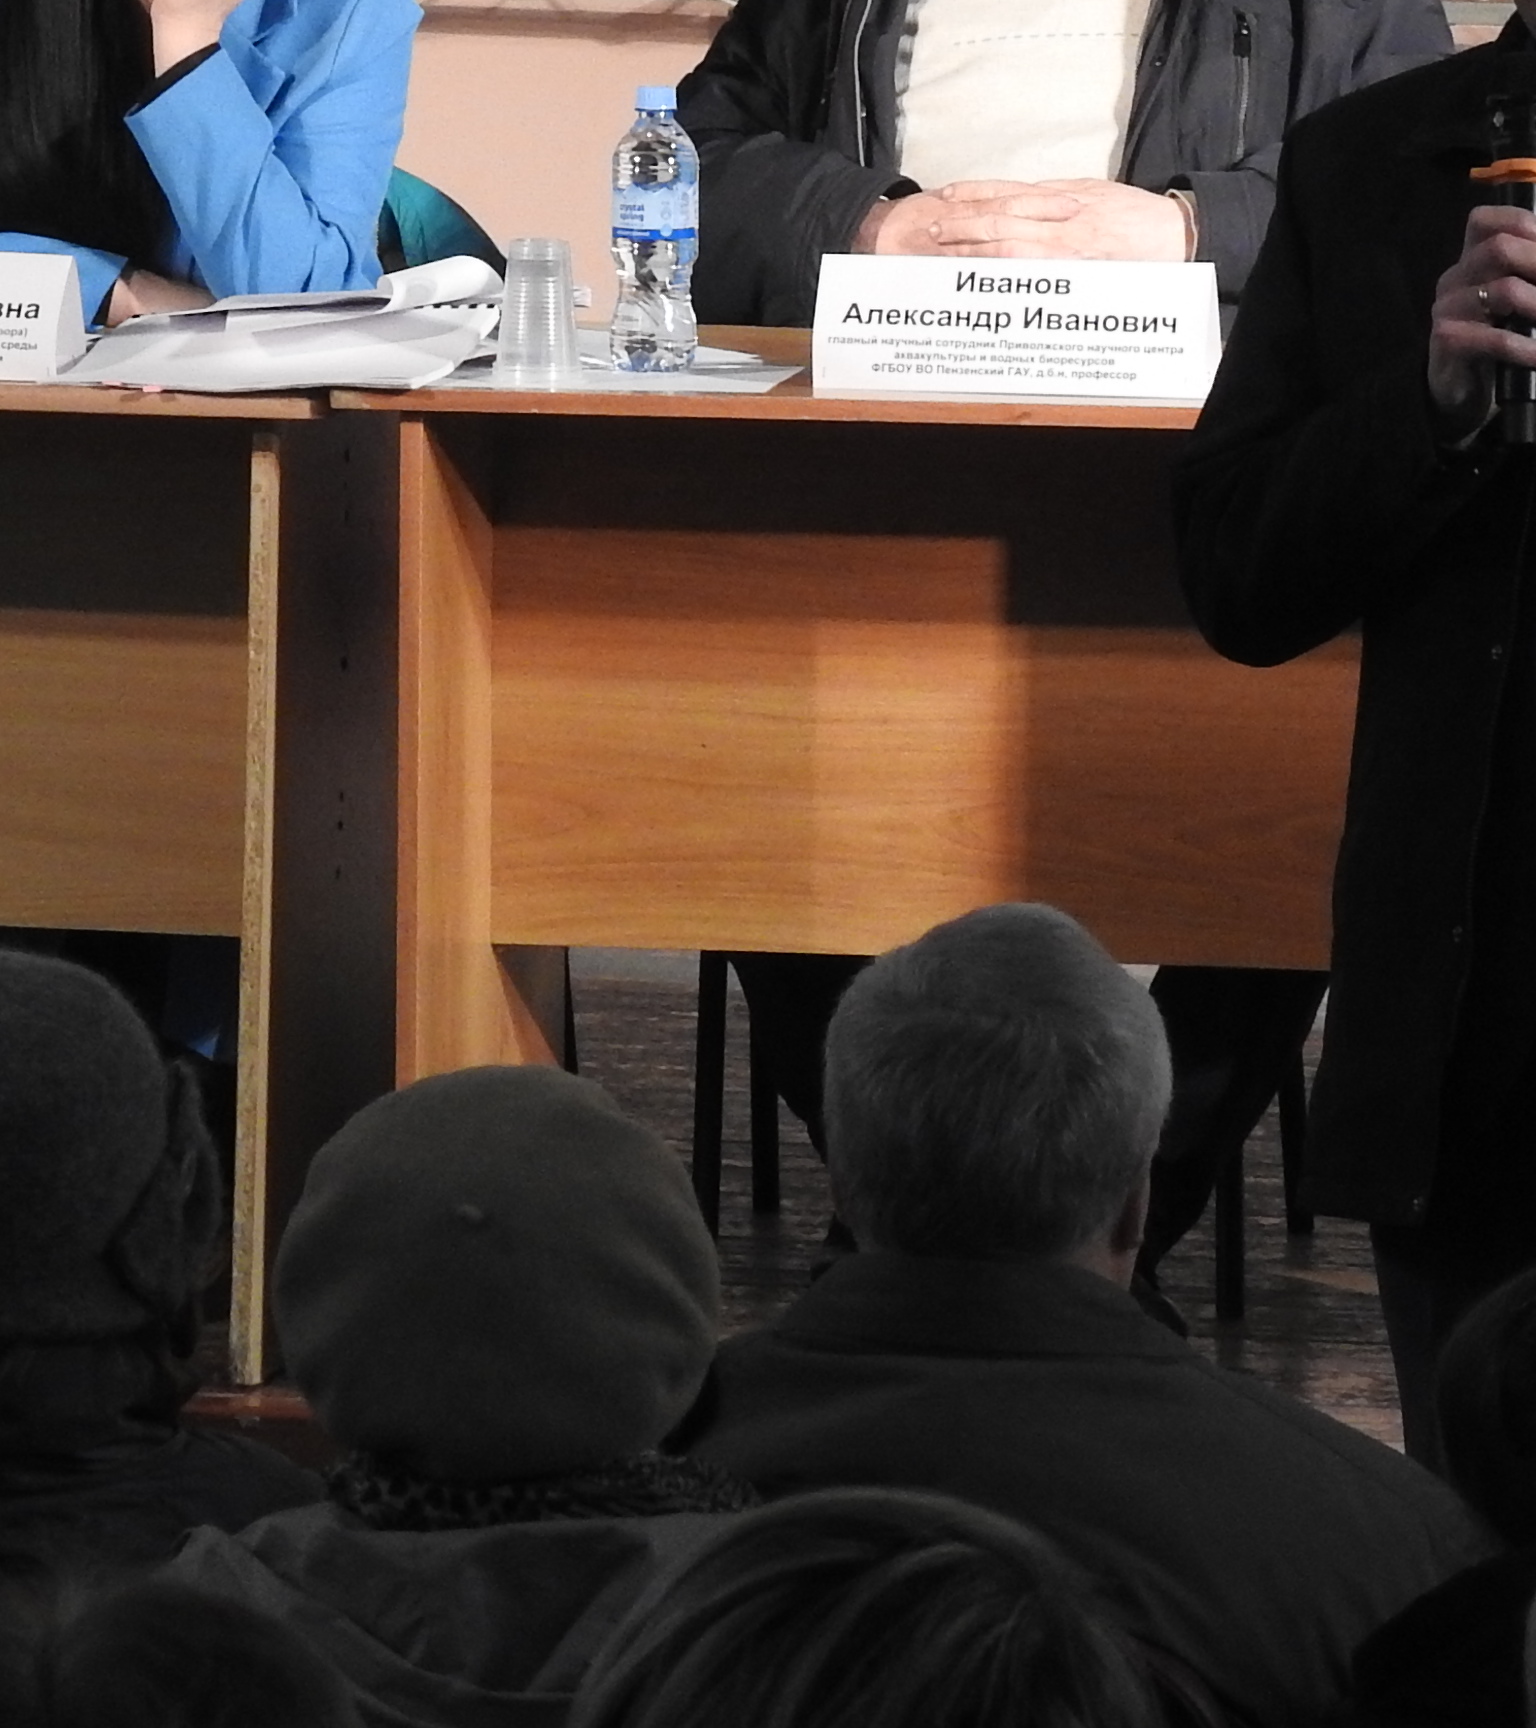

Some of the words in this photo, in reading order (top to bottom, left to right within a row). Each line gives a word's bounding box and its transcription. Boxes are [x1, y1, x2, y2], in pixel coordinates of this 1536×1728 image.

[955, 271, 1071, 295] Иванов
[841, 303, 1012, 334] Александр
[1023, 307, 1178, 334] Иванович
[1, 341, 37, 351] среды
[827, 335, 877, 345] главный
[881, 337, 932, 347] научный
[935, 339, 996, 350] сотрудник
[999, 340, 1084, 352] Приволжского
[1087, 344, 1140, 354] научного
[1143, 345, 1184, 355] центра
[894, 352, 976, 363] аквакультуры
[989, 354, 1035, 363] водных
[1039, 355, 1115, 366] биоресурсов
[871, 363, 913, 374] ФГБОУ
[916, 364, 933, 374] ВО
[936, 365, 1004, 376] Пензенский
[1008, 367, 1033, 378] ГАУ,
[1071, 370, 1137, 381] профессор
